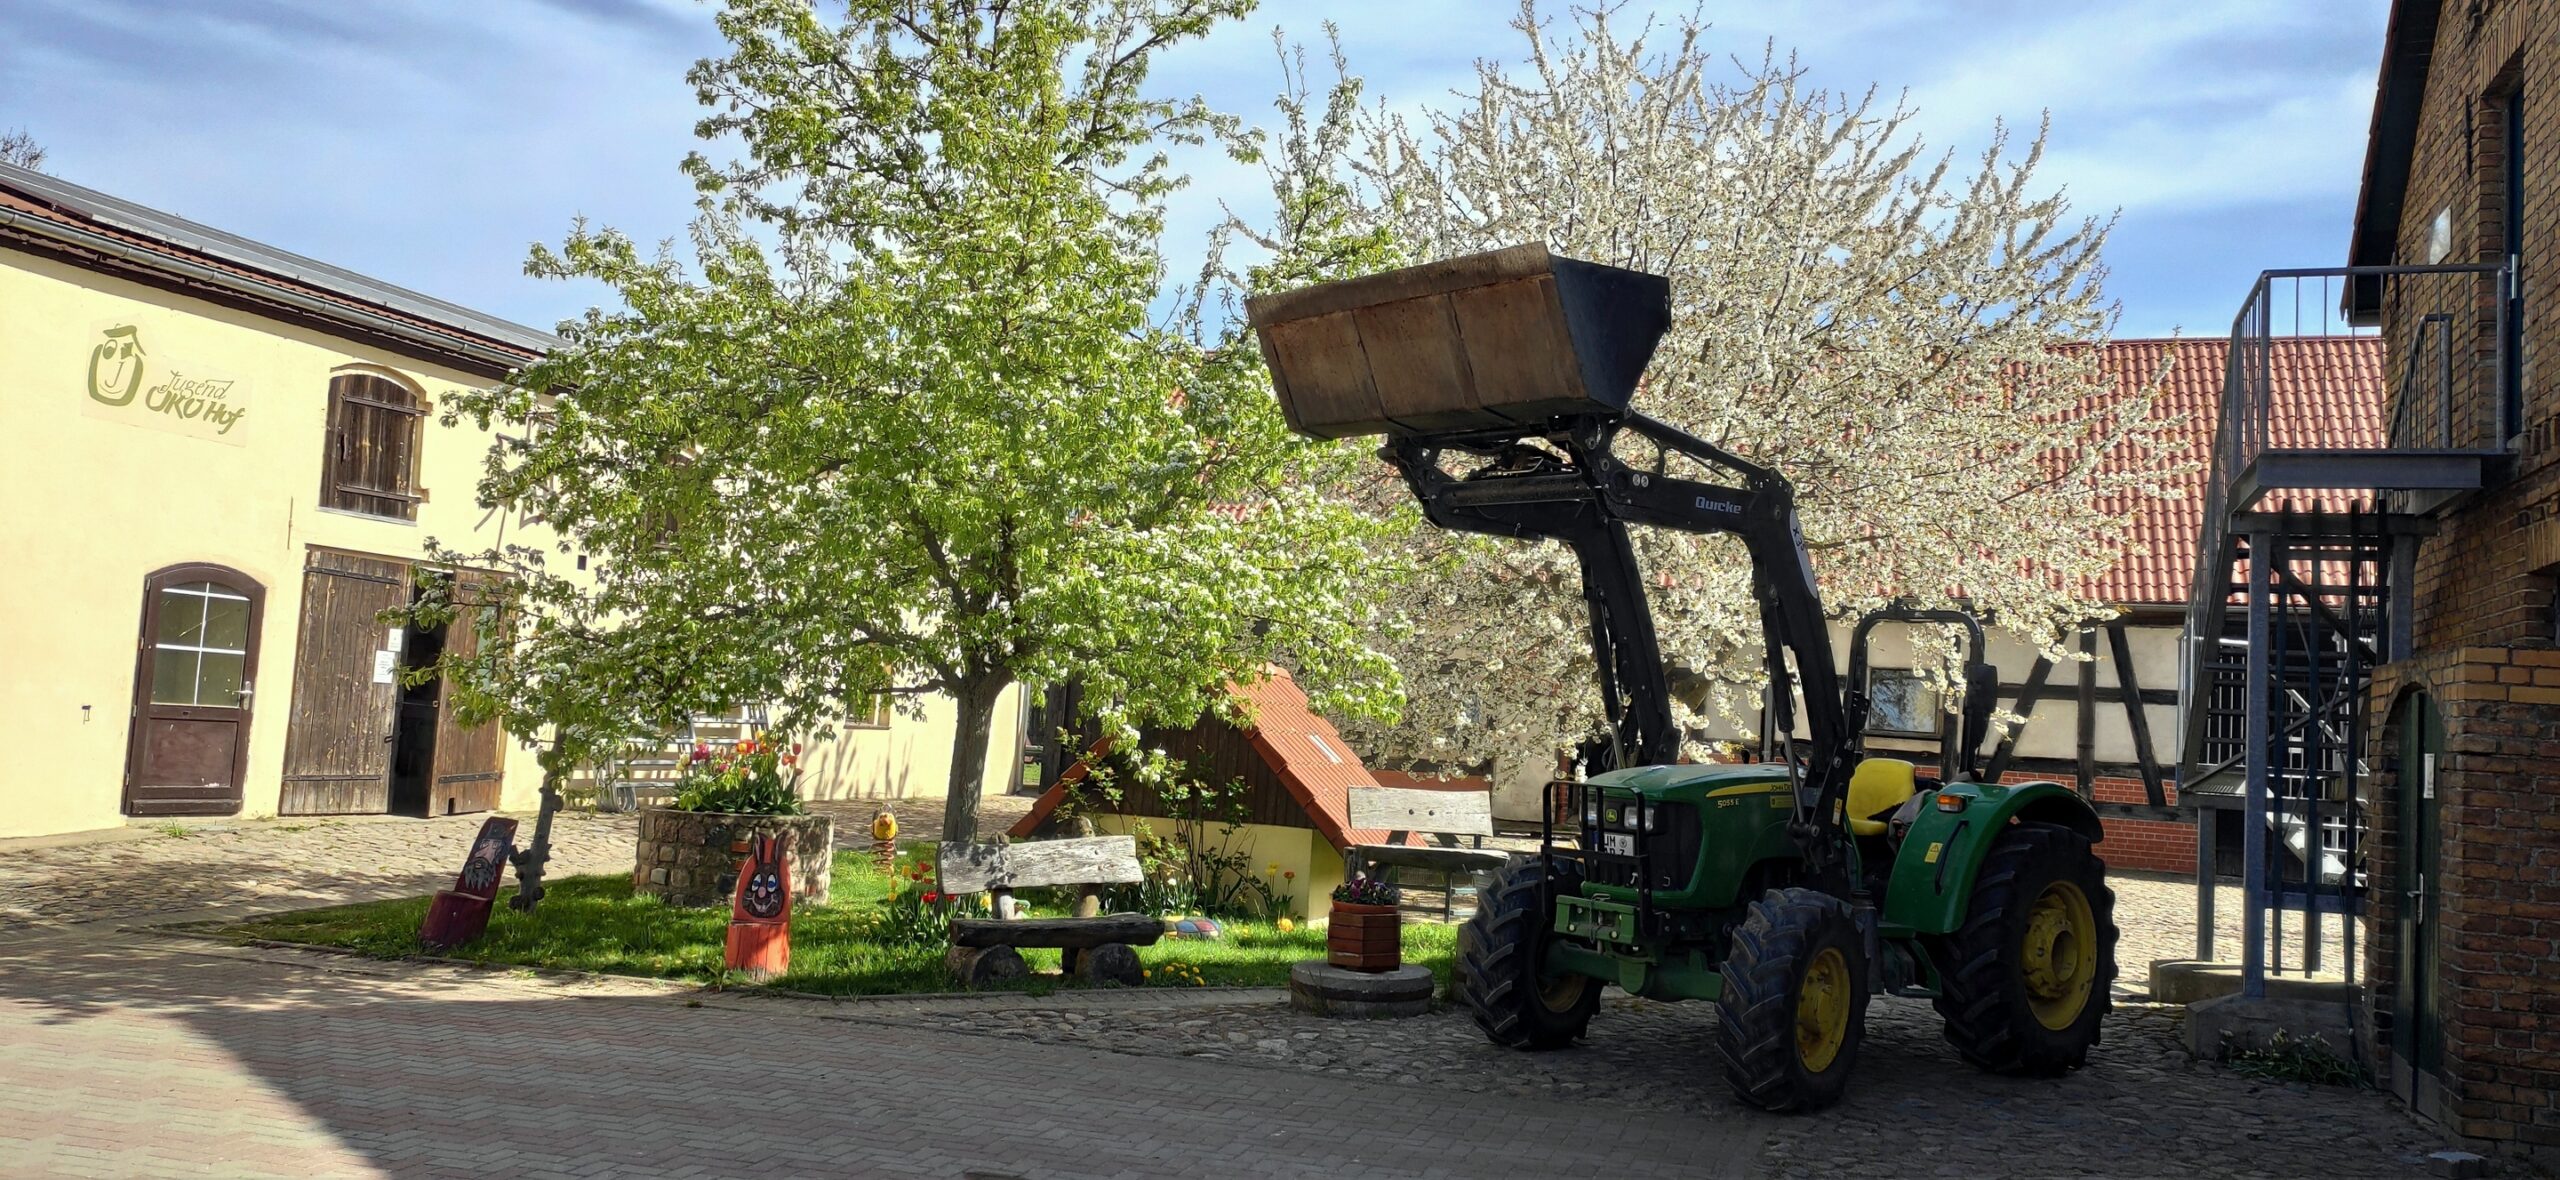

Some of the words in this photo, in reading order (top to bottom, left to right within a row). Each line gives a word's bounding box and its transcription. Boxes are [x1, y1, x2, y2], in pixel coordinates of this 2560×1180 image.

[158, 370, 234, 399] Jugend
[203, 402, 246, 435] Hof
[1695, 496, 1742, 514] Quicke
